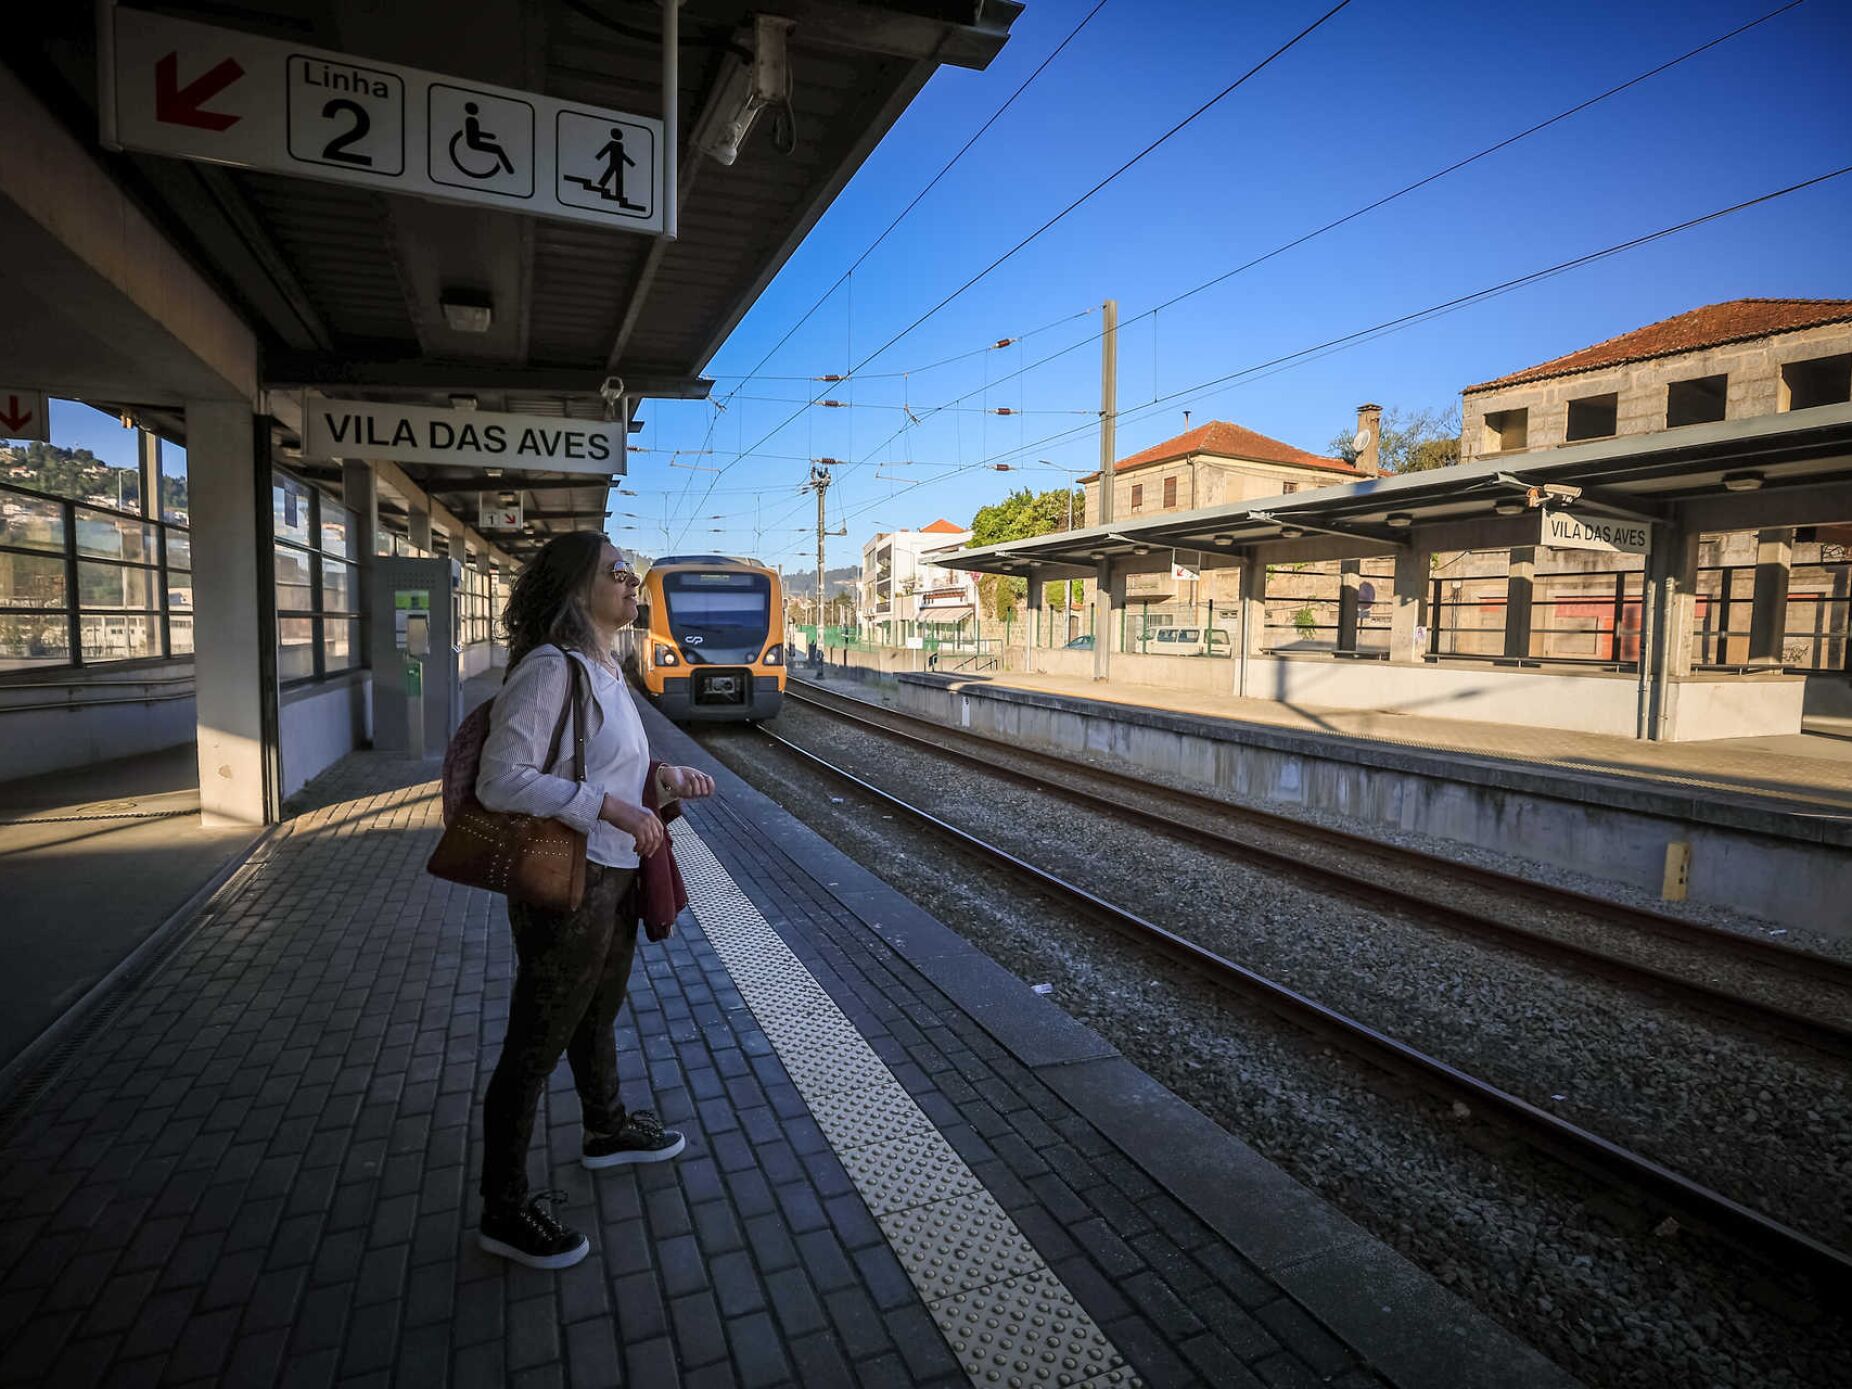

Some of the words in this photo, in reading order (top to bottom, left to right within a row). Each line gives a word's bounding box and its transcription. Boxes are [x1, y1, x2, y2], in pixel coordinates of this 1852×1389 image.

[304, 61, 388, 98] Linha
[322, 98, 372, 166] 2
[324, 413, 418, 448] VILA
[429, 421, 507, 453] DAS
[517, 428, 610, 460] AVES
[1552, 520, 1581, 539] VILA
[1584, 524, 1611, 543] DAS
[1613, 527, 1646, 547] AVES
